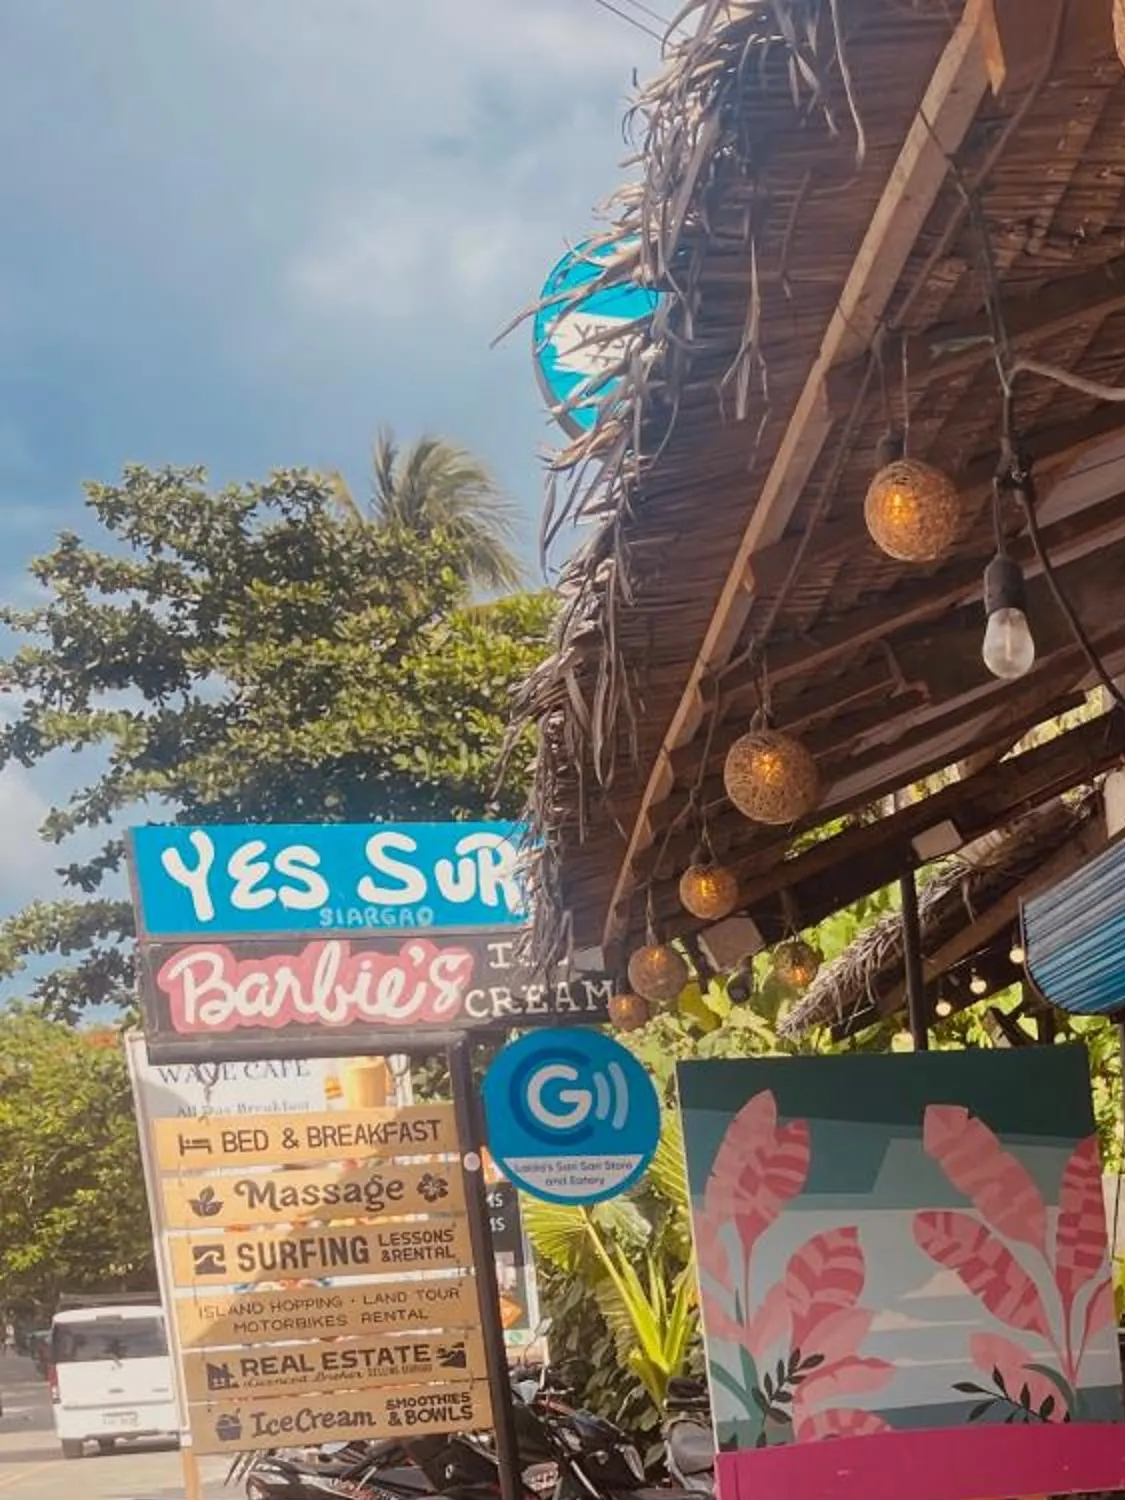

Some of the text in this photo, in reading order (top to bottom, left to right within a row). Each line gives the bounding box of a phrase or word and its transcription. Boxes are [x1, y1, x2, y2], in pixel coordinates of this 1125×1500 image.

[161, 830, 331, 922] YES
[319, 906, 434, 927] SIARGAO
[167, 940, 466, 1025] Barbie's
[465, 980, 613, 1018] CREAM
[221, 1119, 441, 1153] BED & BREAKFAST
[234, 1173, 404, 1212] Massage
[237, 1234, 370, 1272] SURFING
[378, 1228, 454, 1248] LESSONS
[198, 1286, 461, 1319] ISLAND HOPPING LAND TOUR
[232, 1308, 430, 1334] MOTORBIKES RENTAL
[240, 1353, 315, 1378] REAL
[322, 1343, 431, 1371] ESTATE
[386, 1391, 472, 1411] SMOOTHIES
